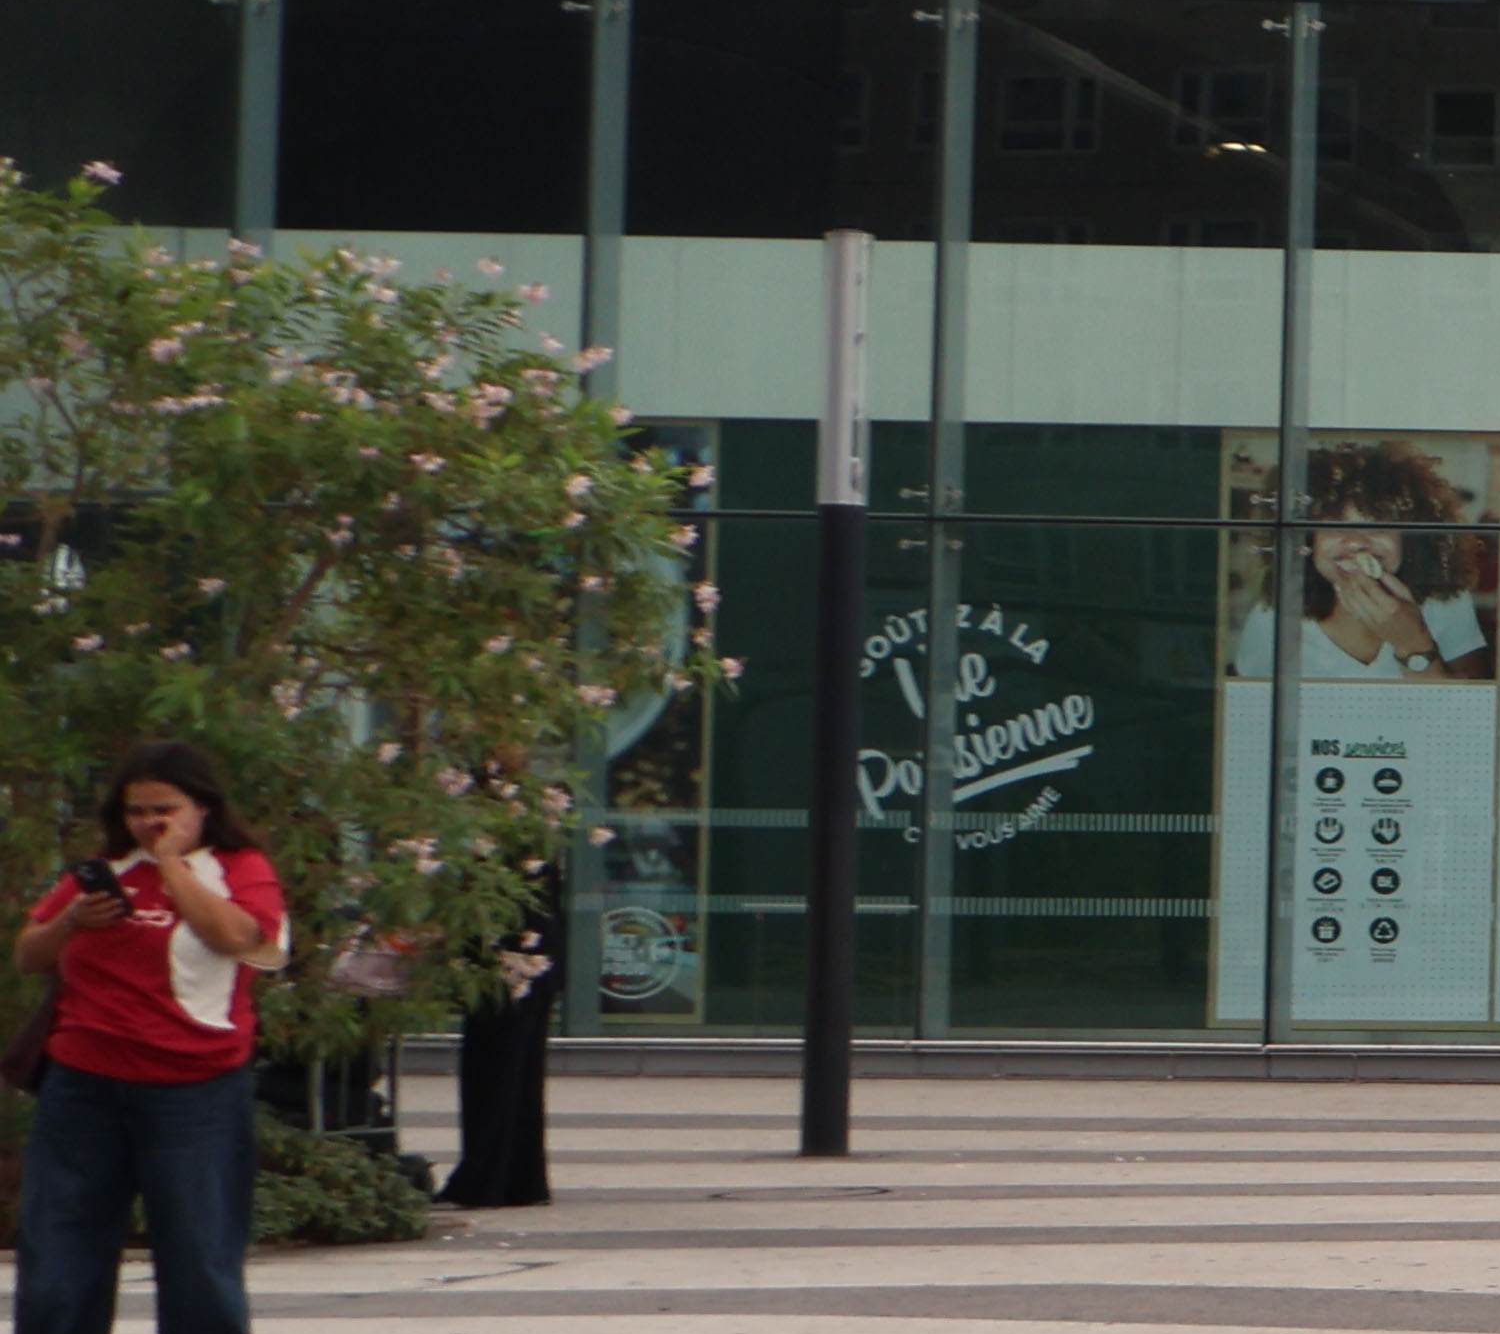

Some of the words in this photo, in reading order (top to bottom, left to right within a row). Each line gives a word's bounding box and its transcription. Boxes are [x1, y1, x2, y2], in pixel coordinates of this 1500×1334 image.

[859, 604, 973, 677] OÛTZ
[1009, 623, 1049, 665] LA
[1311, 739, 1340, 756] NOS
